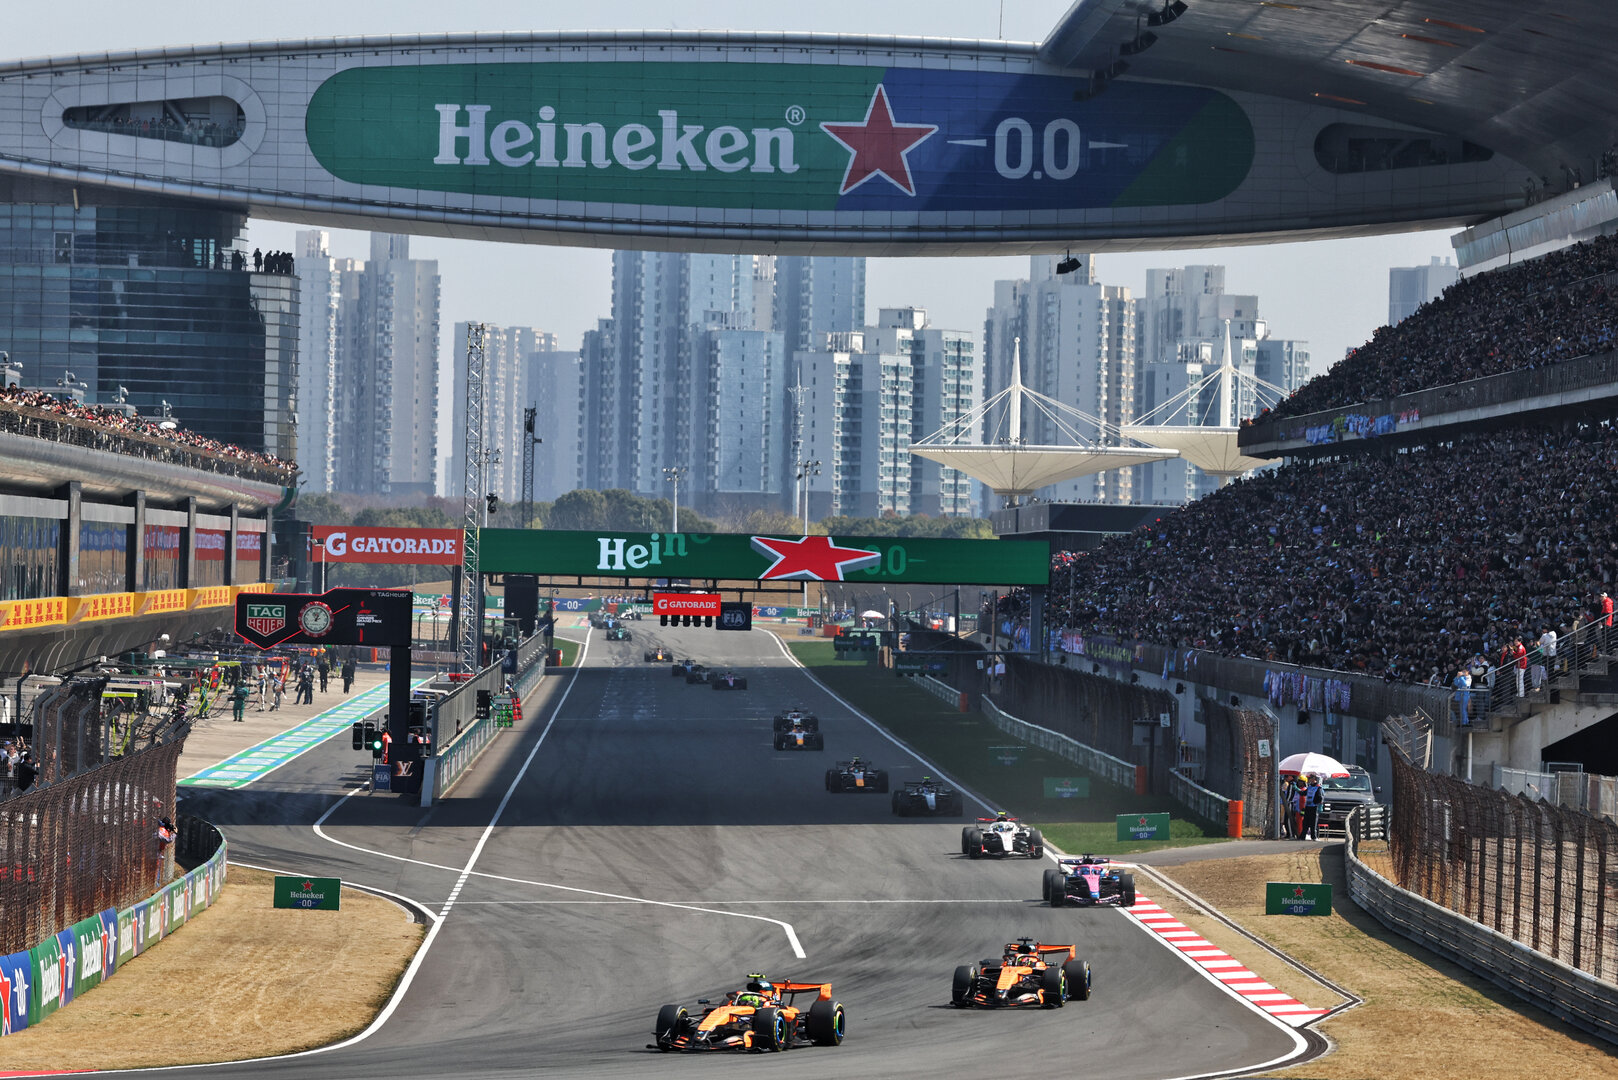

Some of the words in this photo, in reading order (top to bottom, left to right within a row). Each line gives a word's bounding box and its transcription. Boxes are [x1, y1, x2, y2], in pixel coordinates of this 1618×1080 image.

[994, 117, 1081, 180] 0.0
[351, 537, 456, 555] GATORADE
[669, 600, 717, 609] GATORADE
[250, 606, 282, 617] TAG
[722, 613, 745, 624] FIA
[248, 618, 284, 634] HEUER
[290, 891, 325, 900] Heineken
[1281, 897, 1317, 905] Heineken
